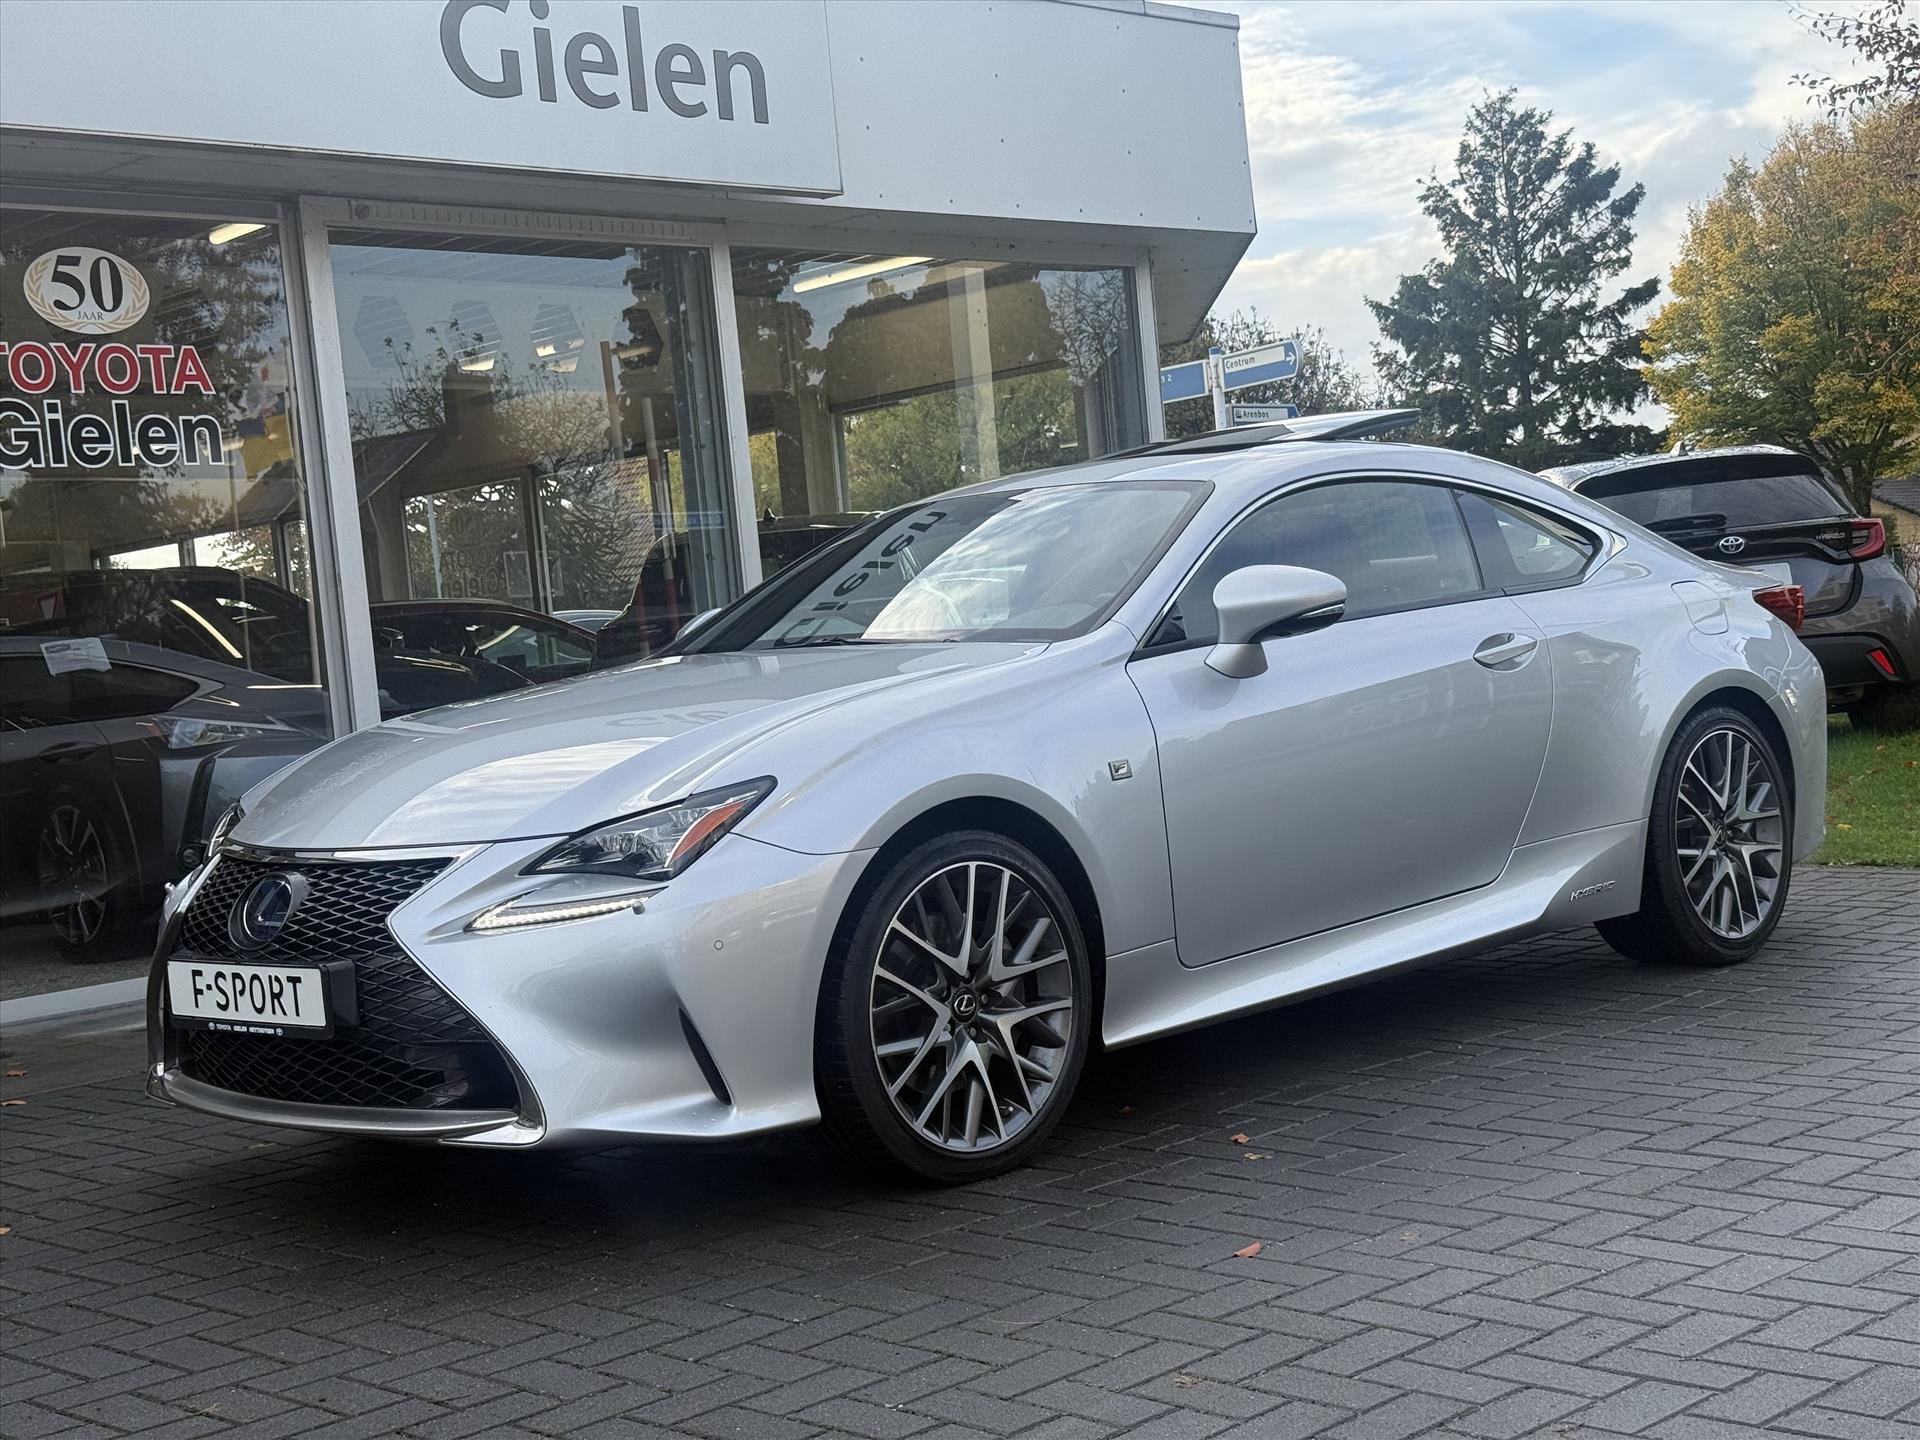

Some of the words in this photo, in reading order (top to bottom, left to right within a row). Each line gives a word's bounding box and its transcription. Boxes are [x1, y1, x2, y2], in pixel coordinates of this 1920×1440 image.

[439, 0, 769, 124] Gielen
[51, 254, 124, 312] 50
[76, 310, 105, 321] JAAR
[0, 341, 216, 394] OYOTA
[1225, 355, 1256, 370] Centrum
[0, 398, 225, 469] Gielen
[1243, 409, 1270, 419] Arenbos
[191, 969, 303, 1017] F-SPORT
